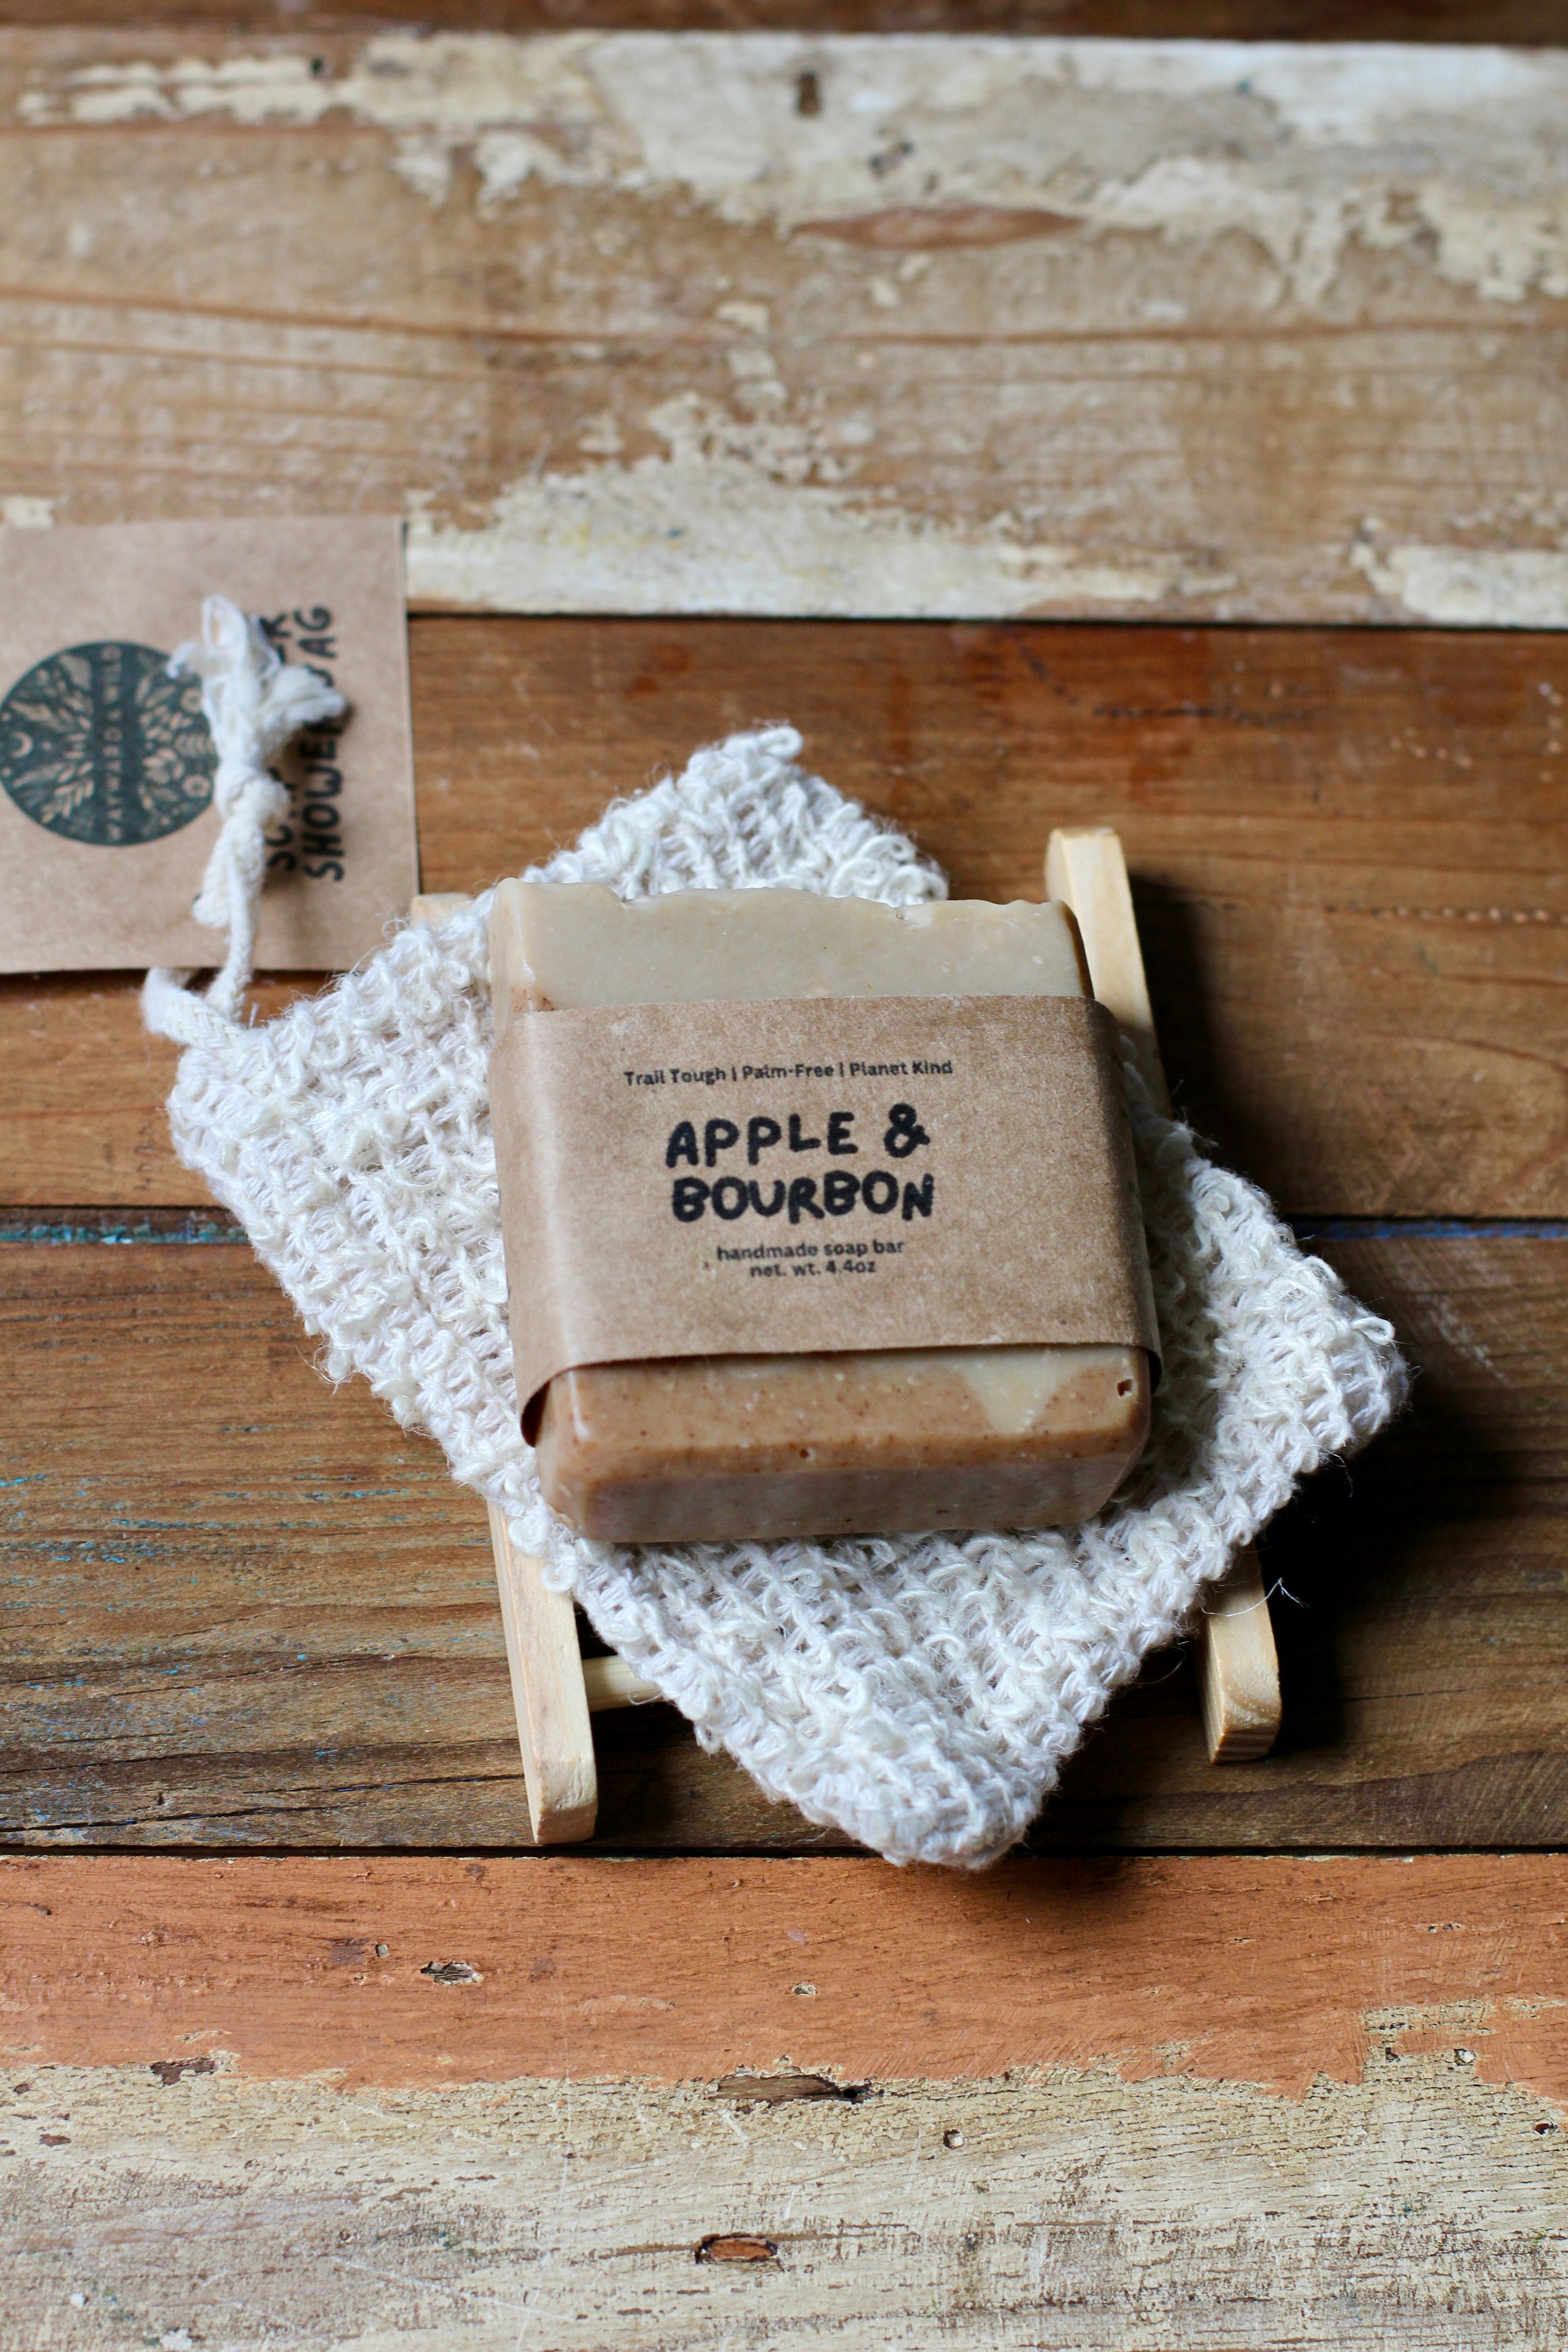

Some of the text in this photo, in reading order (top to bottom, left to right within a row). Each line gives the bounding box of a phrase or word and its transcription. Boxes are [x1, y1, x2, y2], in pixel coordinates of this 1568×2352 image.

[623, 1070, 666, 1086] Trail
[669, 1067, 726, 1085] Tough
[742, 1062, 834, 1080] Palm-Free
[849, 1061, 909, 1076] Planet
[912, 1059, 953, 1075] Kind
[665, 1102, 931, 1168] APPLE &
[671, 1170, 935, 1225] BOURBON
[716, 1239, 904, 1261] handmade soap bar
[749, 1259, 877, 1278] net. wt. 4.4oz
